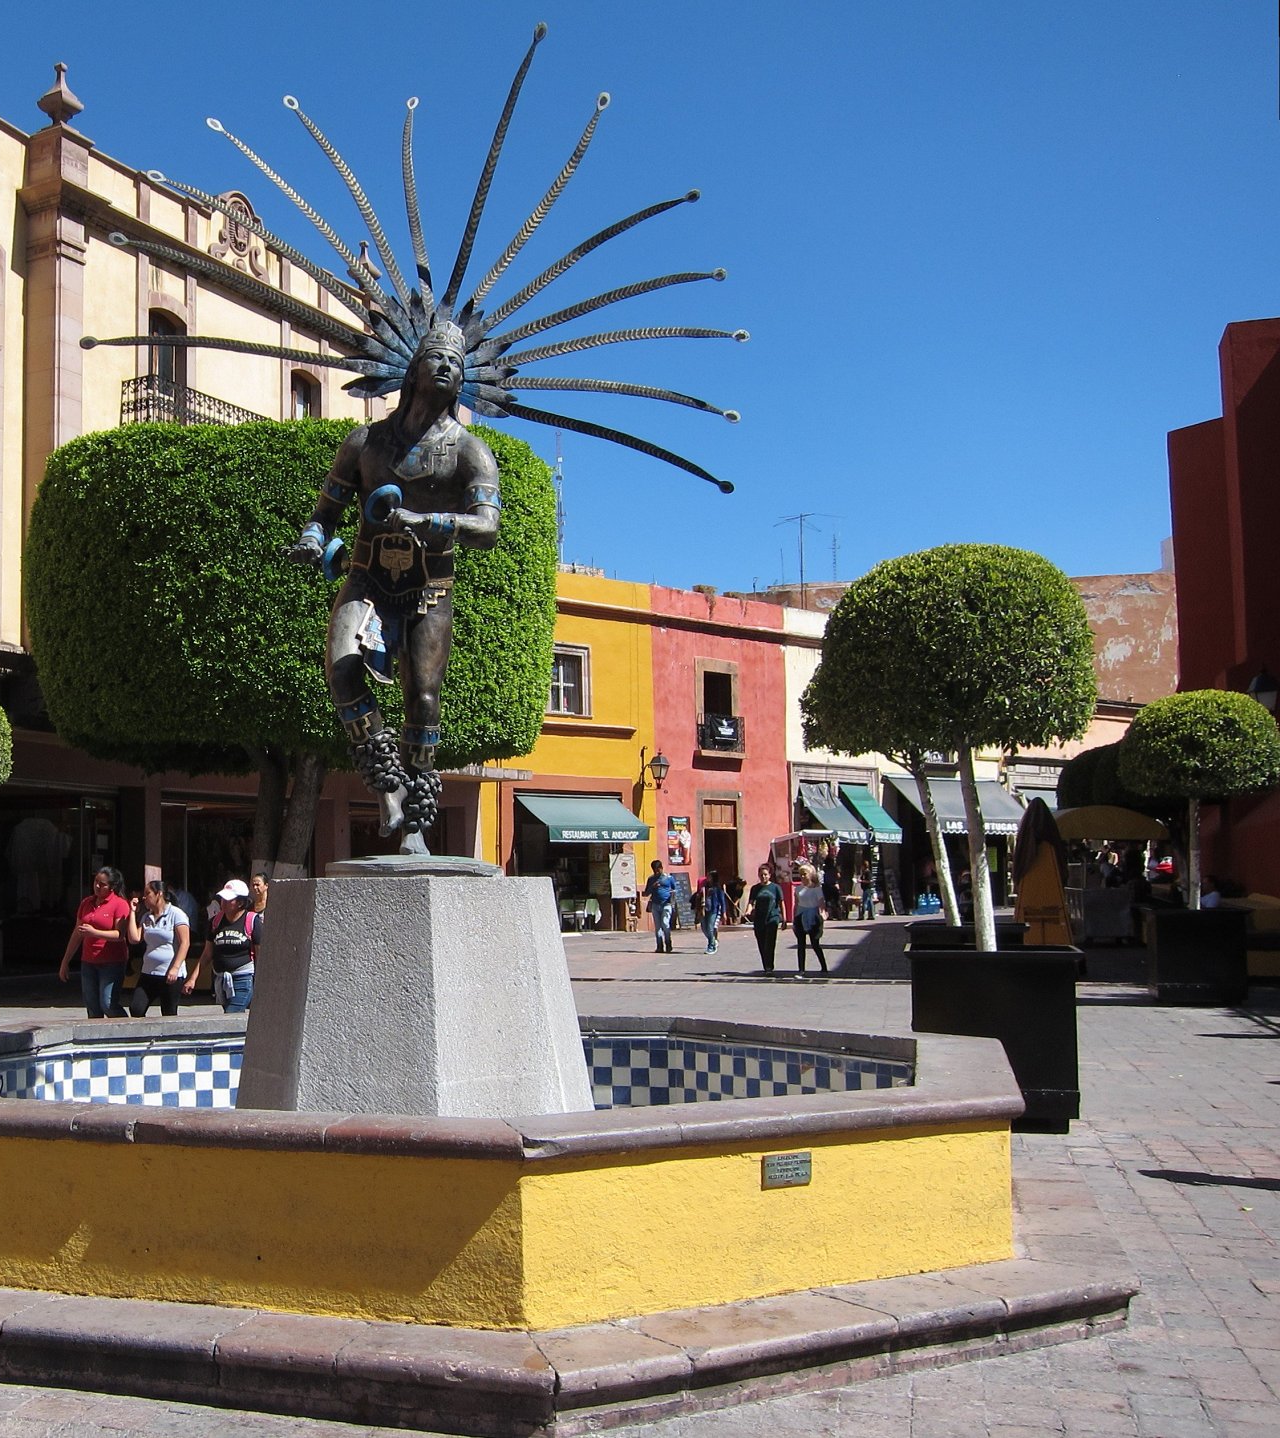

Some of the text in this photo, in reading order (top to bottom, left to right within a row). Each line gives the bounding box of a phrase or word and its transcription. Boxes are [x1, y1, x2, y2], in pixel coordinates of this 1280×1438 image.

[945, 820, 1018, 831] LAS RTUGAS
[561, 830, 598, 839] RESTAURANTE
